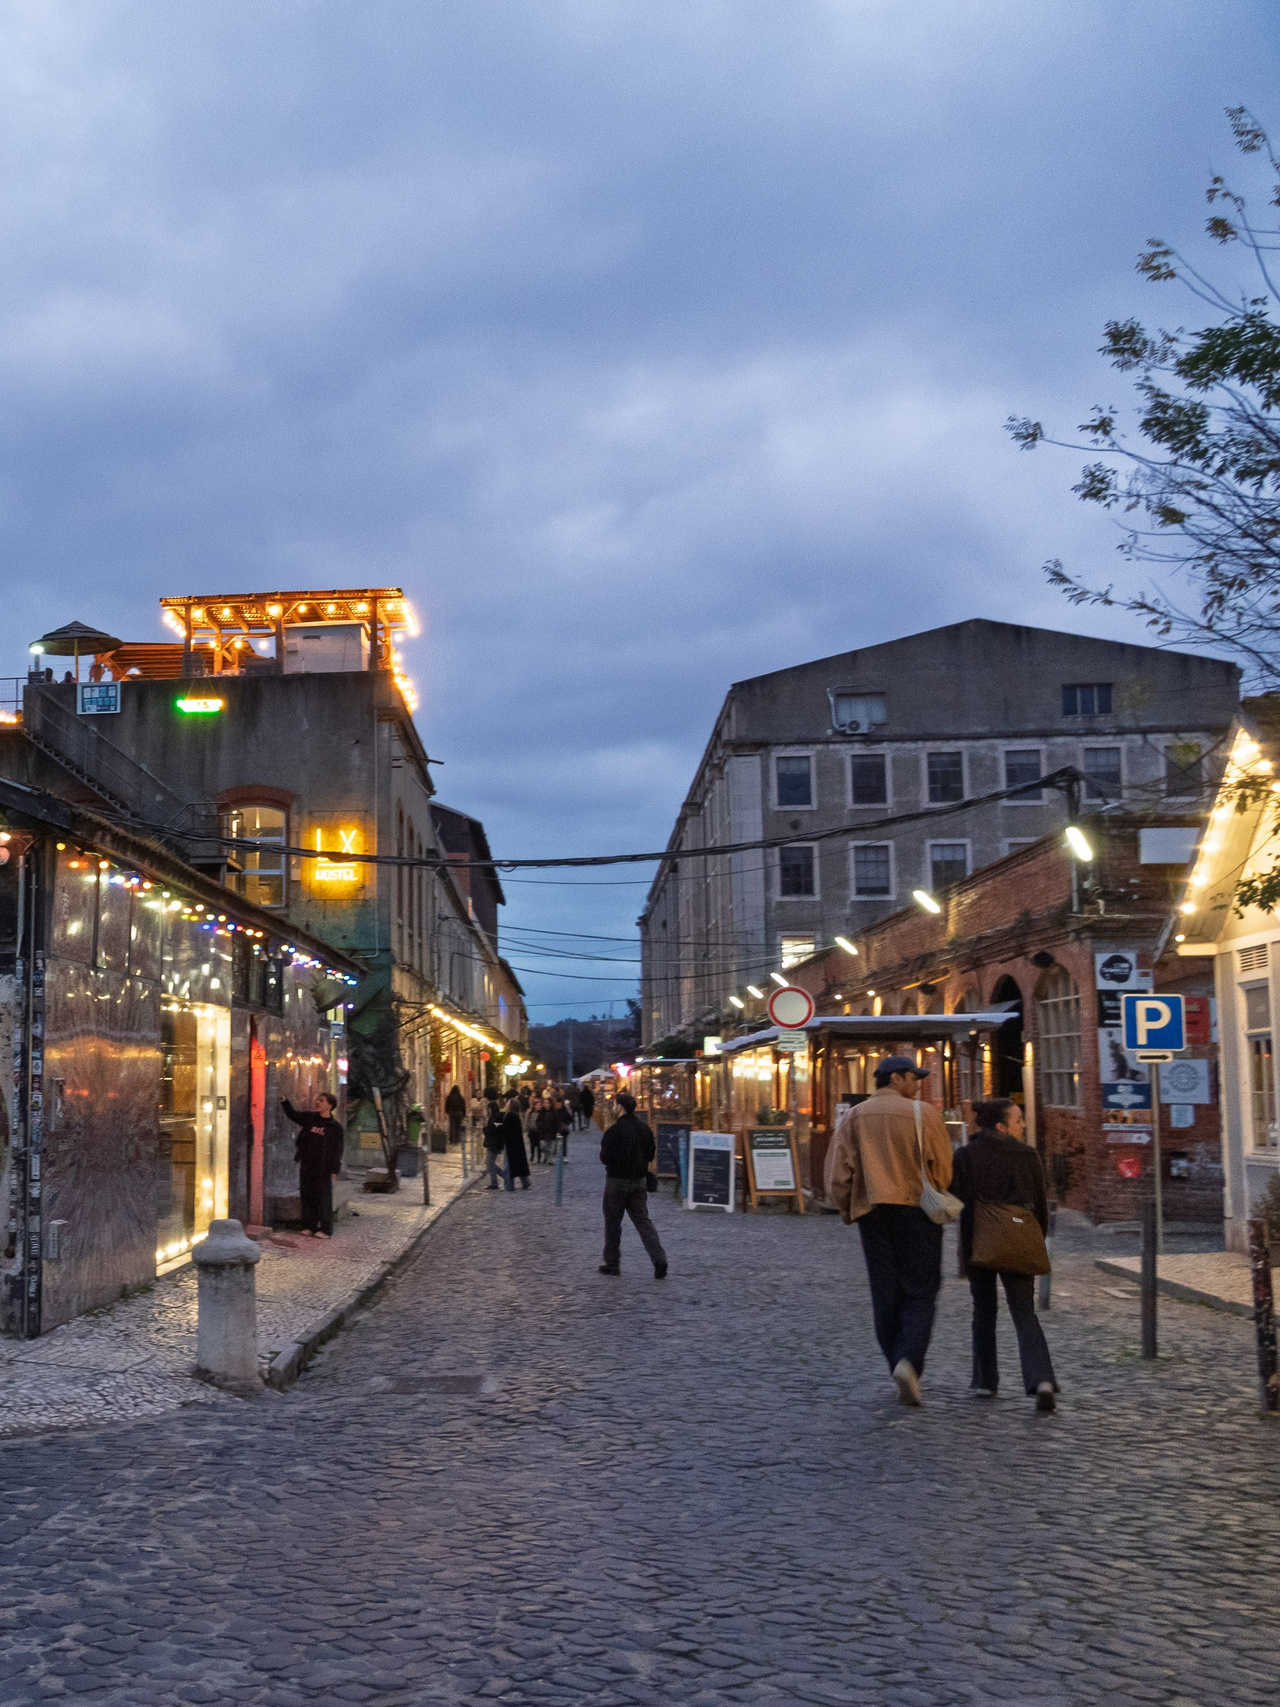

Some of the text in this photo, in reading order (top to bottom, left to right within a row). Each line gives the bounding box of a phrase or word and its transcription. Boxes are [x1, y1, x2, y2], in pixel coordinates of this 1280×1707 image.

[316, 828, 357, 861] LX
[315, 869, 358, 881] HOSTEL
[1135, 1000, 1172, 1046] P
